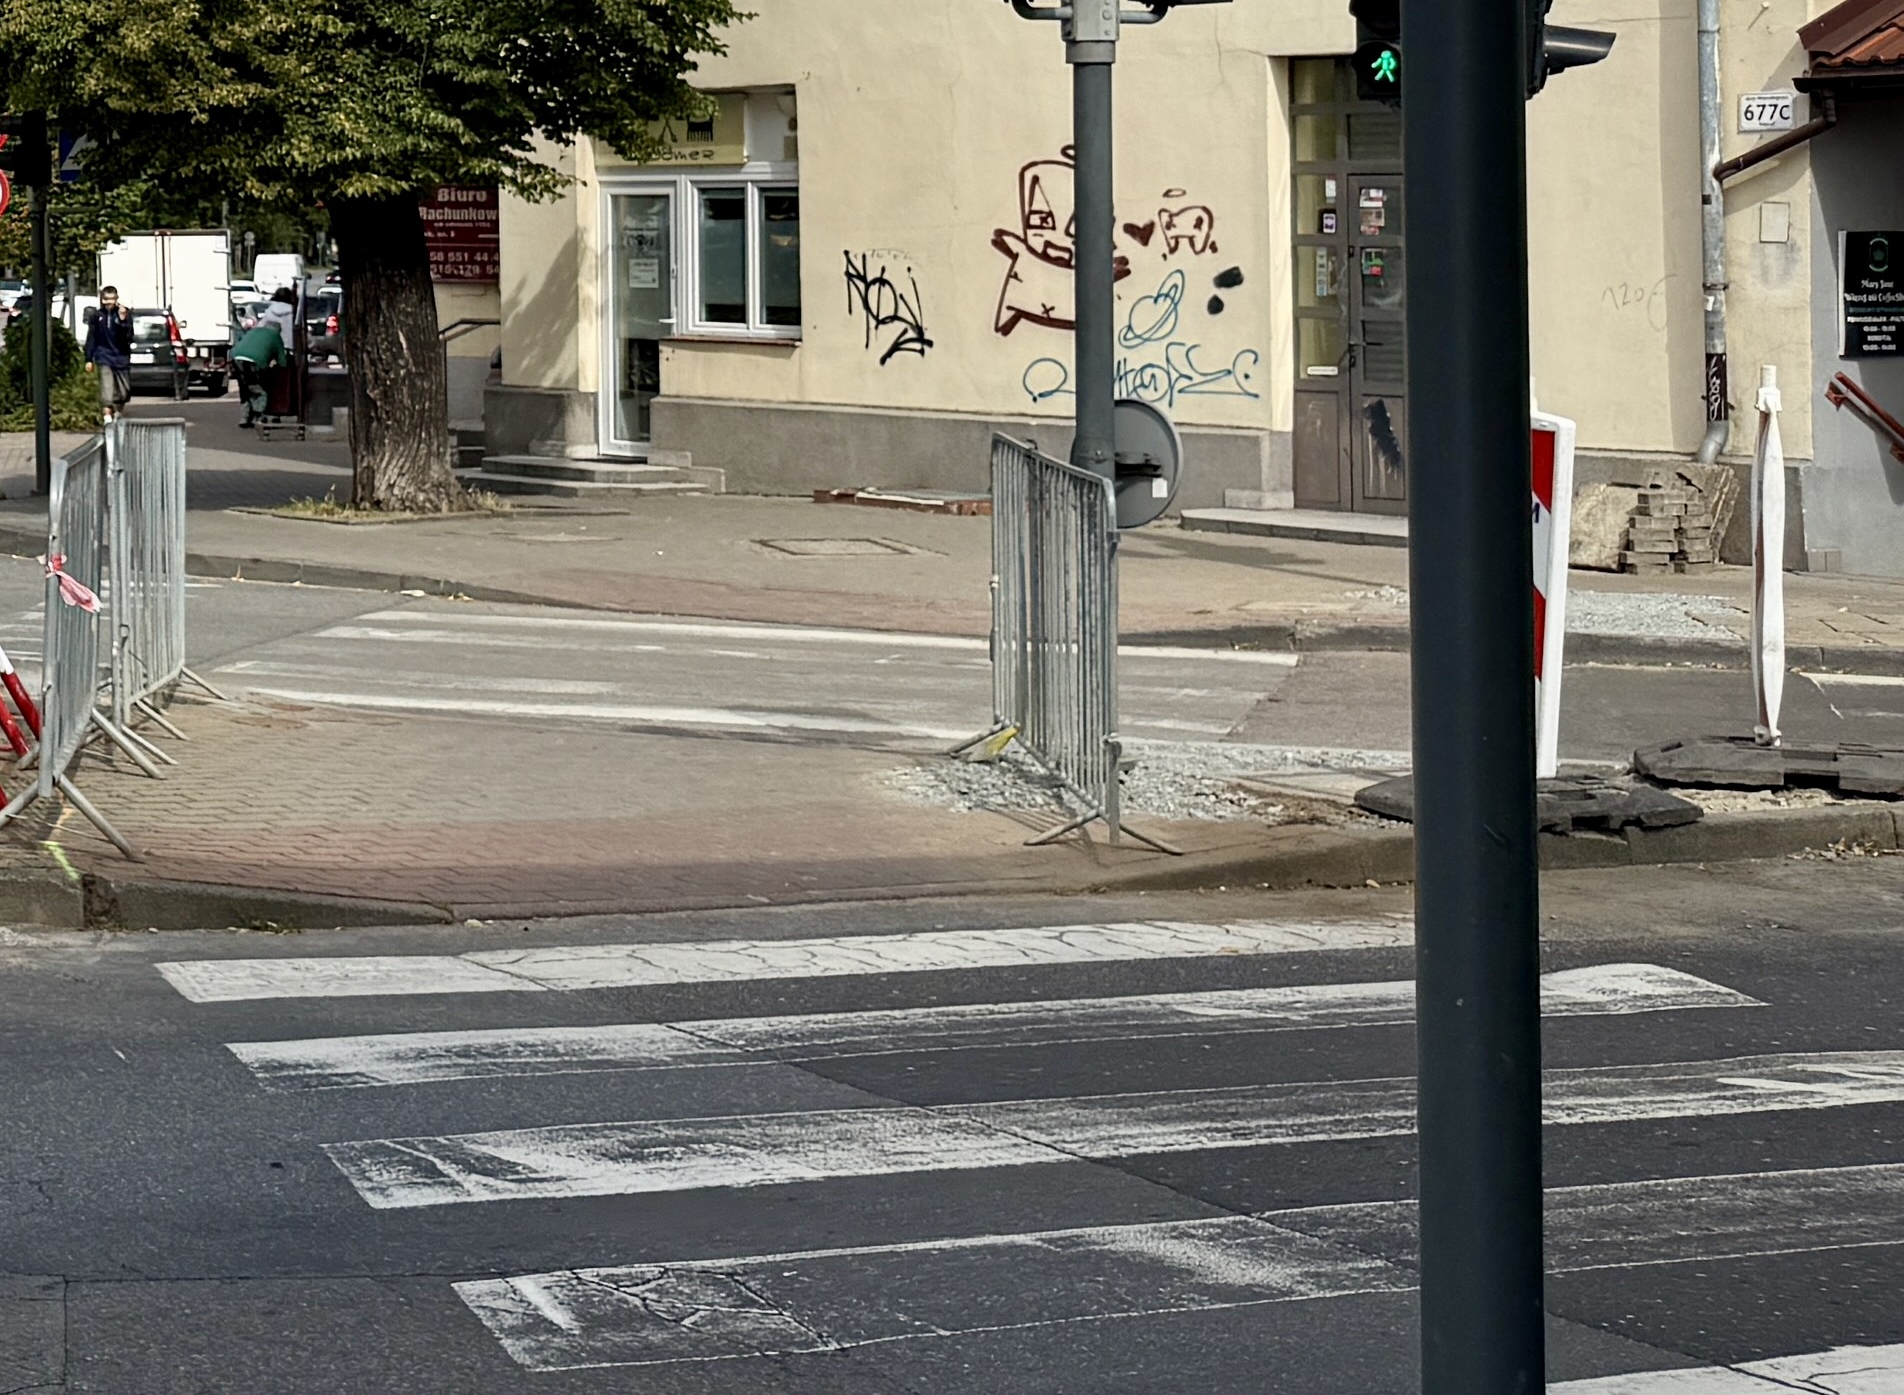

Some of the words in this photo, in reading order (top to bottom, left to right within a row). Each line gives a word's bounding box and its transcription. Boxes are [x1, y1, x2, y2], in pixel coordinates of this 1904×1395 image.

[1744, 104, 1791, 121] 677C
[437, 187, 488, 202] Biuro
[418, 206, 498, 221] Rachunkow
